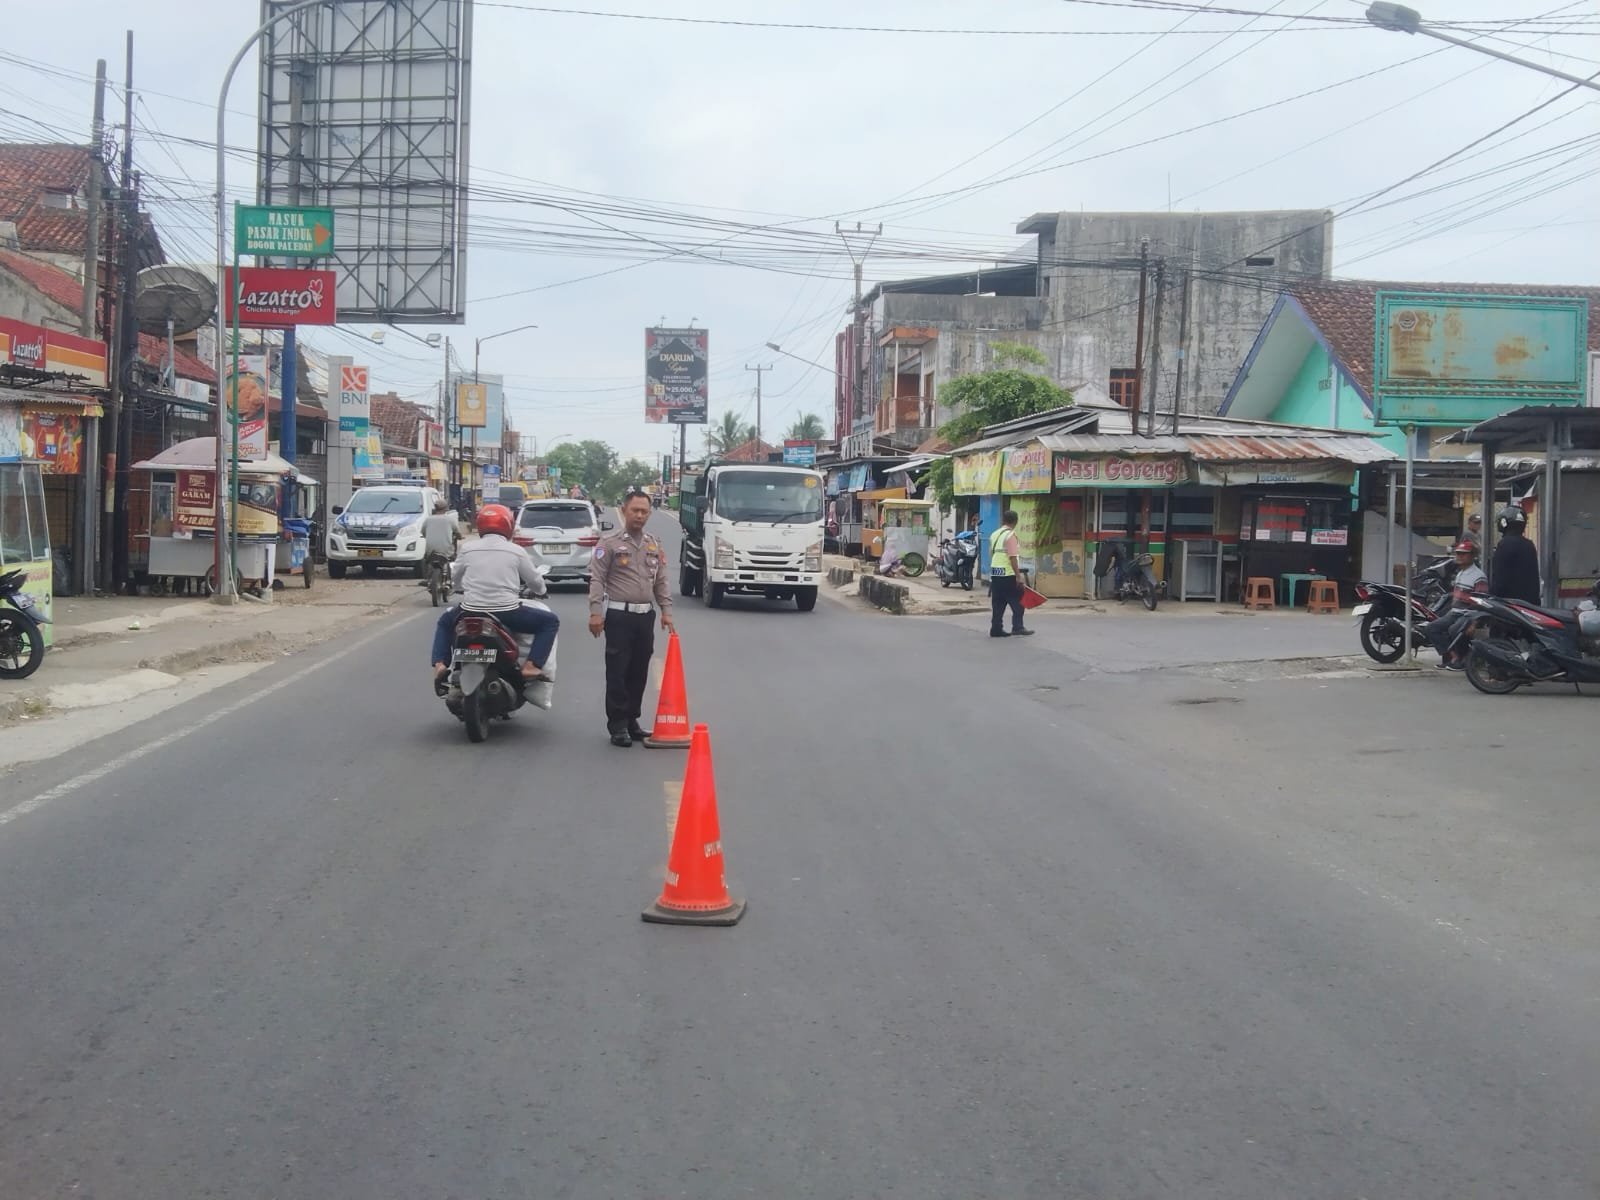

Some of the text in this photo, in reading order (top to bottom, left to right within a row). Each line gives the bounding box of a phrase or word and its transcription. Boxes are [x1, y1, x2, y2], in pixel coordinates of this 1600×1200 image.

[268, 212, 304, 226] MASUK
[247, 226, 312, 241] PASAR INDUK
[238, 281, 312, 308] Lazatto
[660, 353, 695, 362] DJARUM
[341, 391, 367, 405] BNI
[1055, 454, 1099, 481] Nasi
[1104, 455, 1177, 484] Goreng
[182, 490, 211, 500] GARAM
